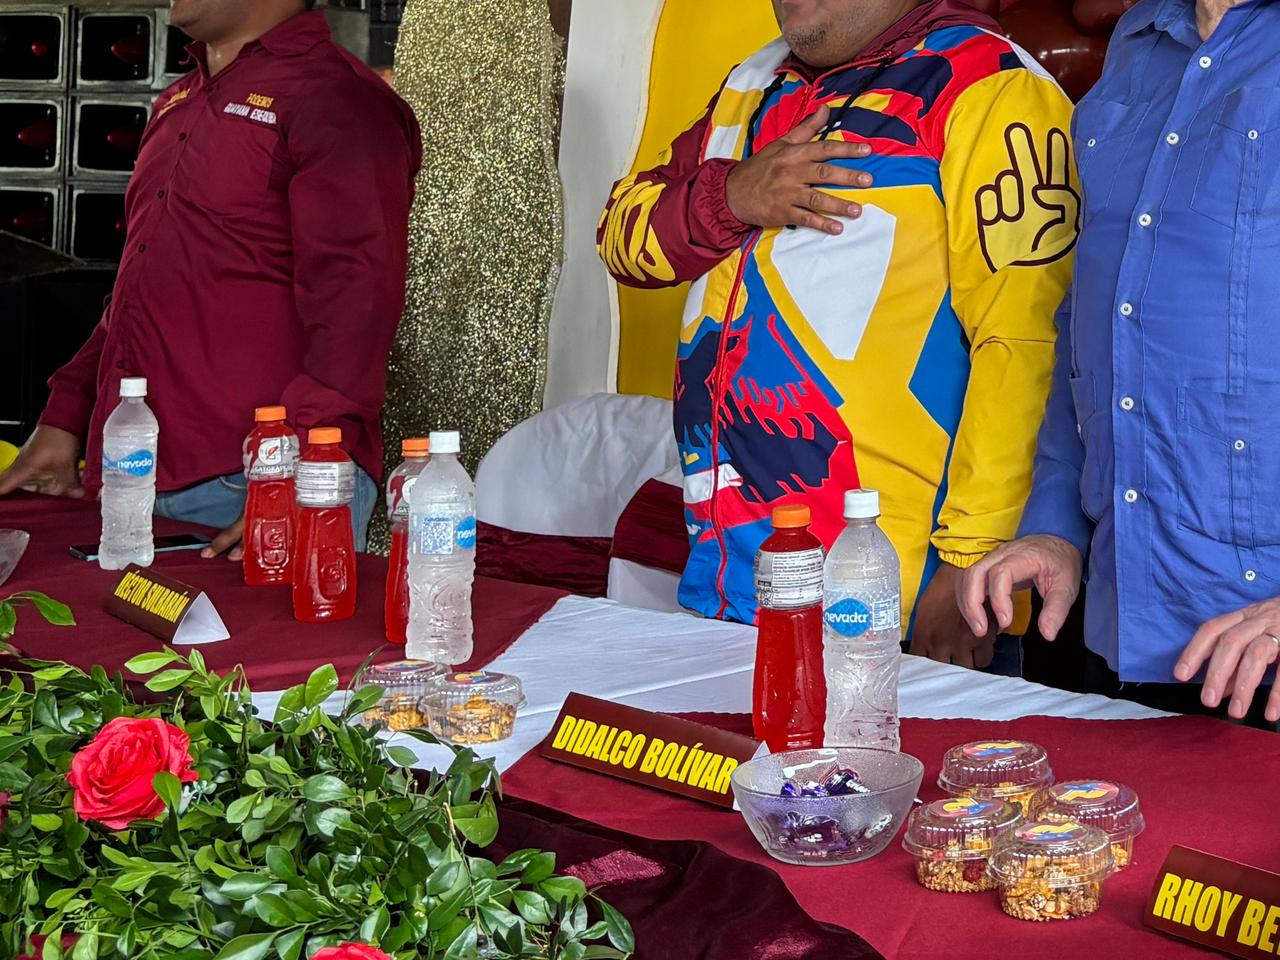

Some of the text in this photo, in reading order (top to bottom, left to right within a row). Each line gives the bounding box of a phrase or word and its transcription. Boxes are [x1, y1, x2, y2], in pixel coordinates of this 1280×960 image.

[117, 457, 153, 469] nevada
[825, 611, 868, 624] nevada
[552, 715, 739, 795] DIDALCO BOLÍVAR
[1153, 872, 1243, 938] RHOY
